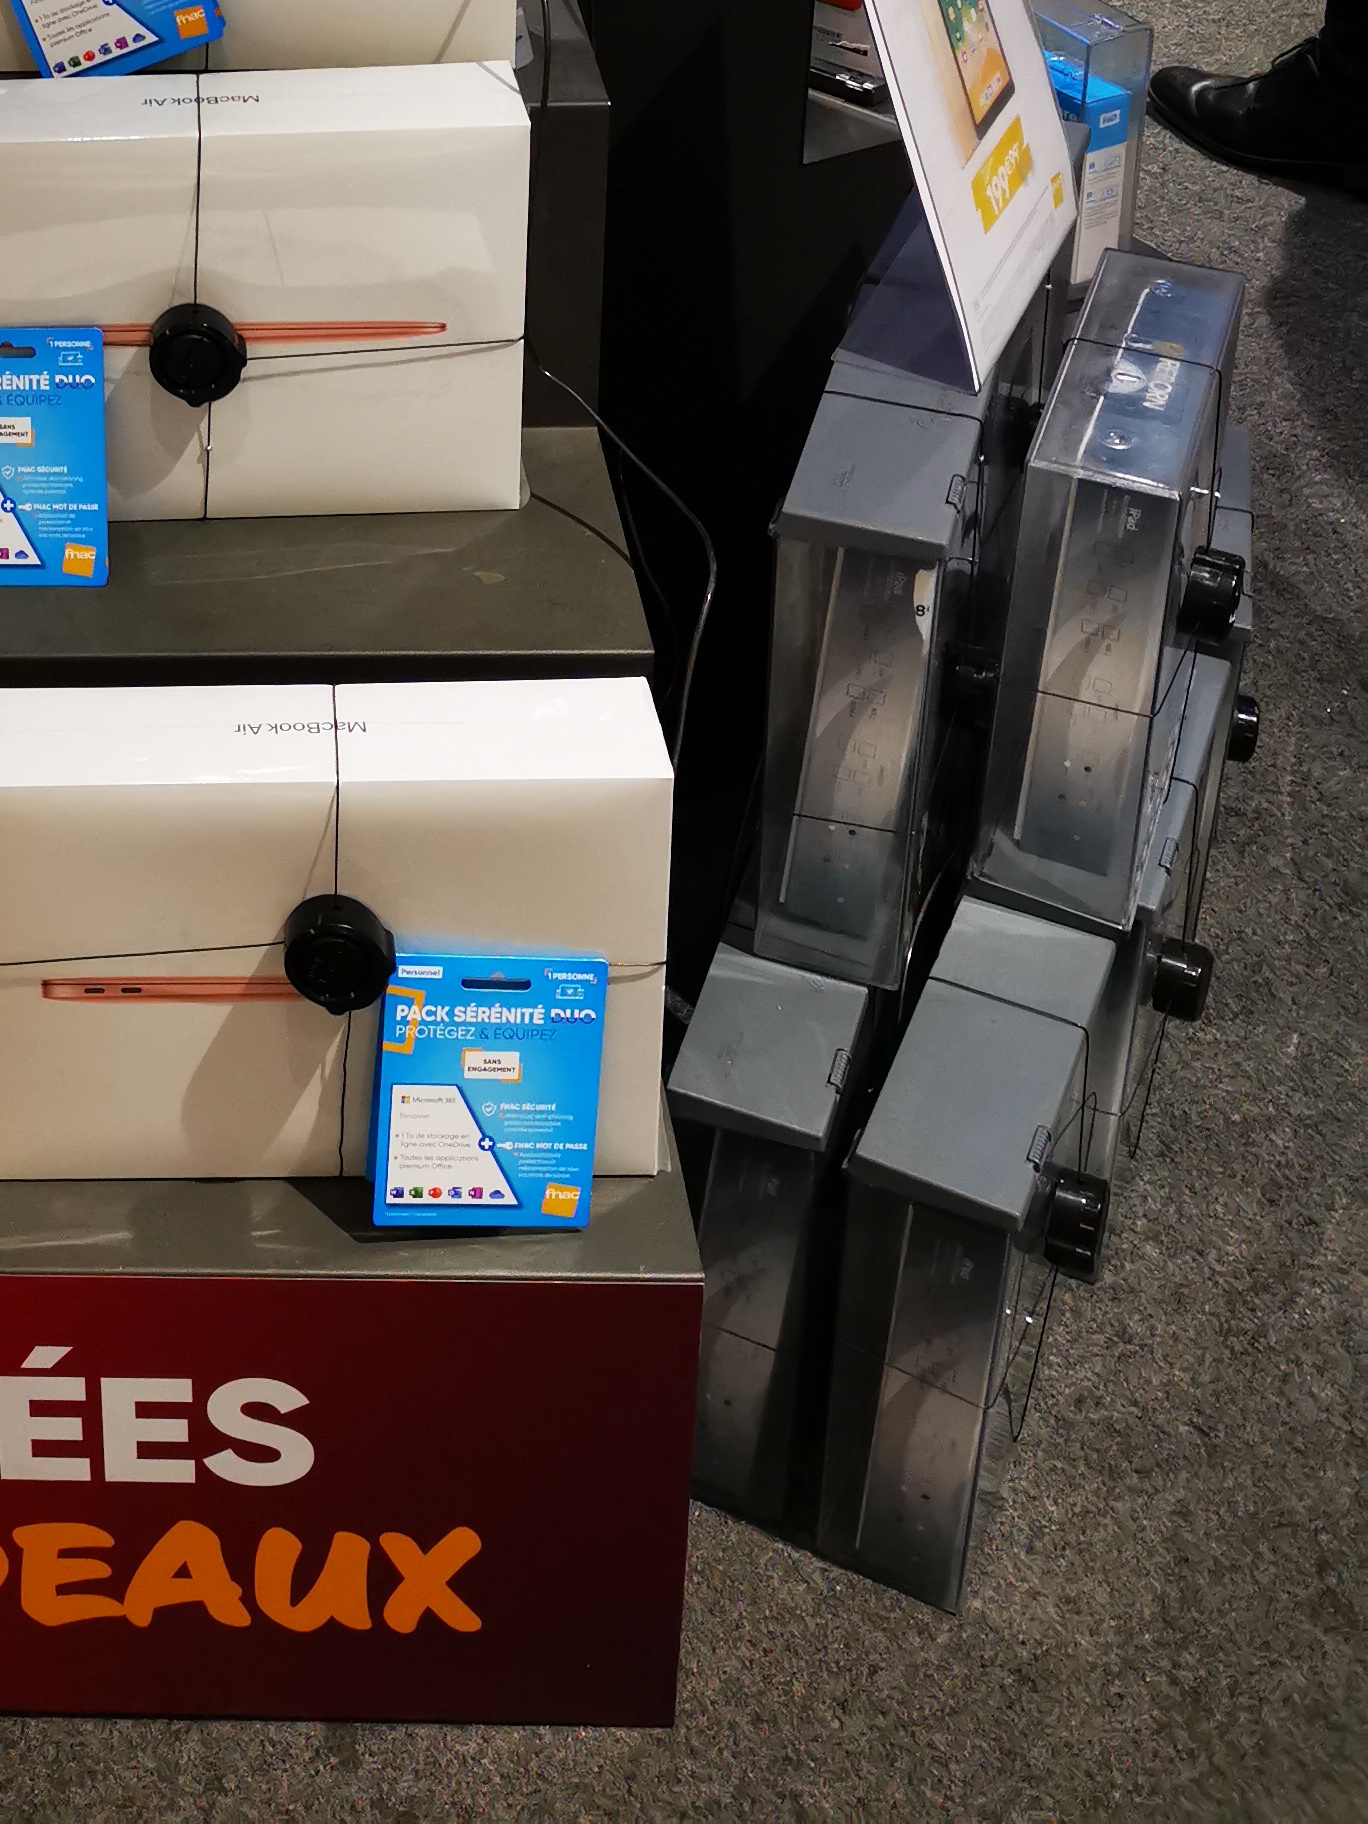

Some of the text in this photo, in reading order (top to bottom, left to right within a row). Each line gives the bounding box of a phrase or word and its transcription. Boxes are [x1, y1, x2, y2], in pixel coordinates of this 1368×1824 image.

[142, 94, 260, 108] MacBook Air
[55, 376, 95, 389] DUO
[234, 721, 367, 734] MacBook Air
[396, 1005, 596, 1024] PACK SÉRÉNITÉ DUO
[396, 1025, 557, 1041] PROTÉGEZ & ÉQUIPEZ
[547, 1188, 580, 1200] fnac
